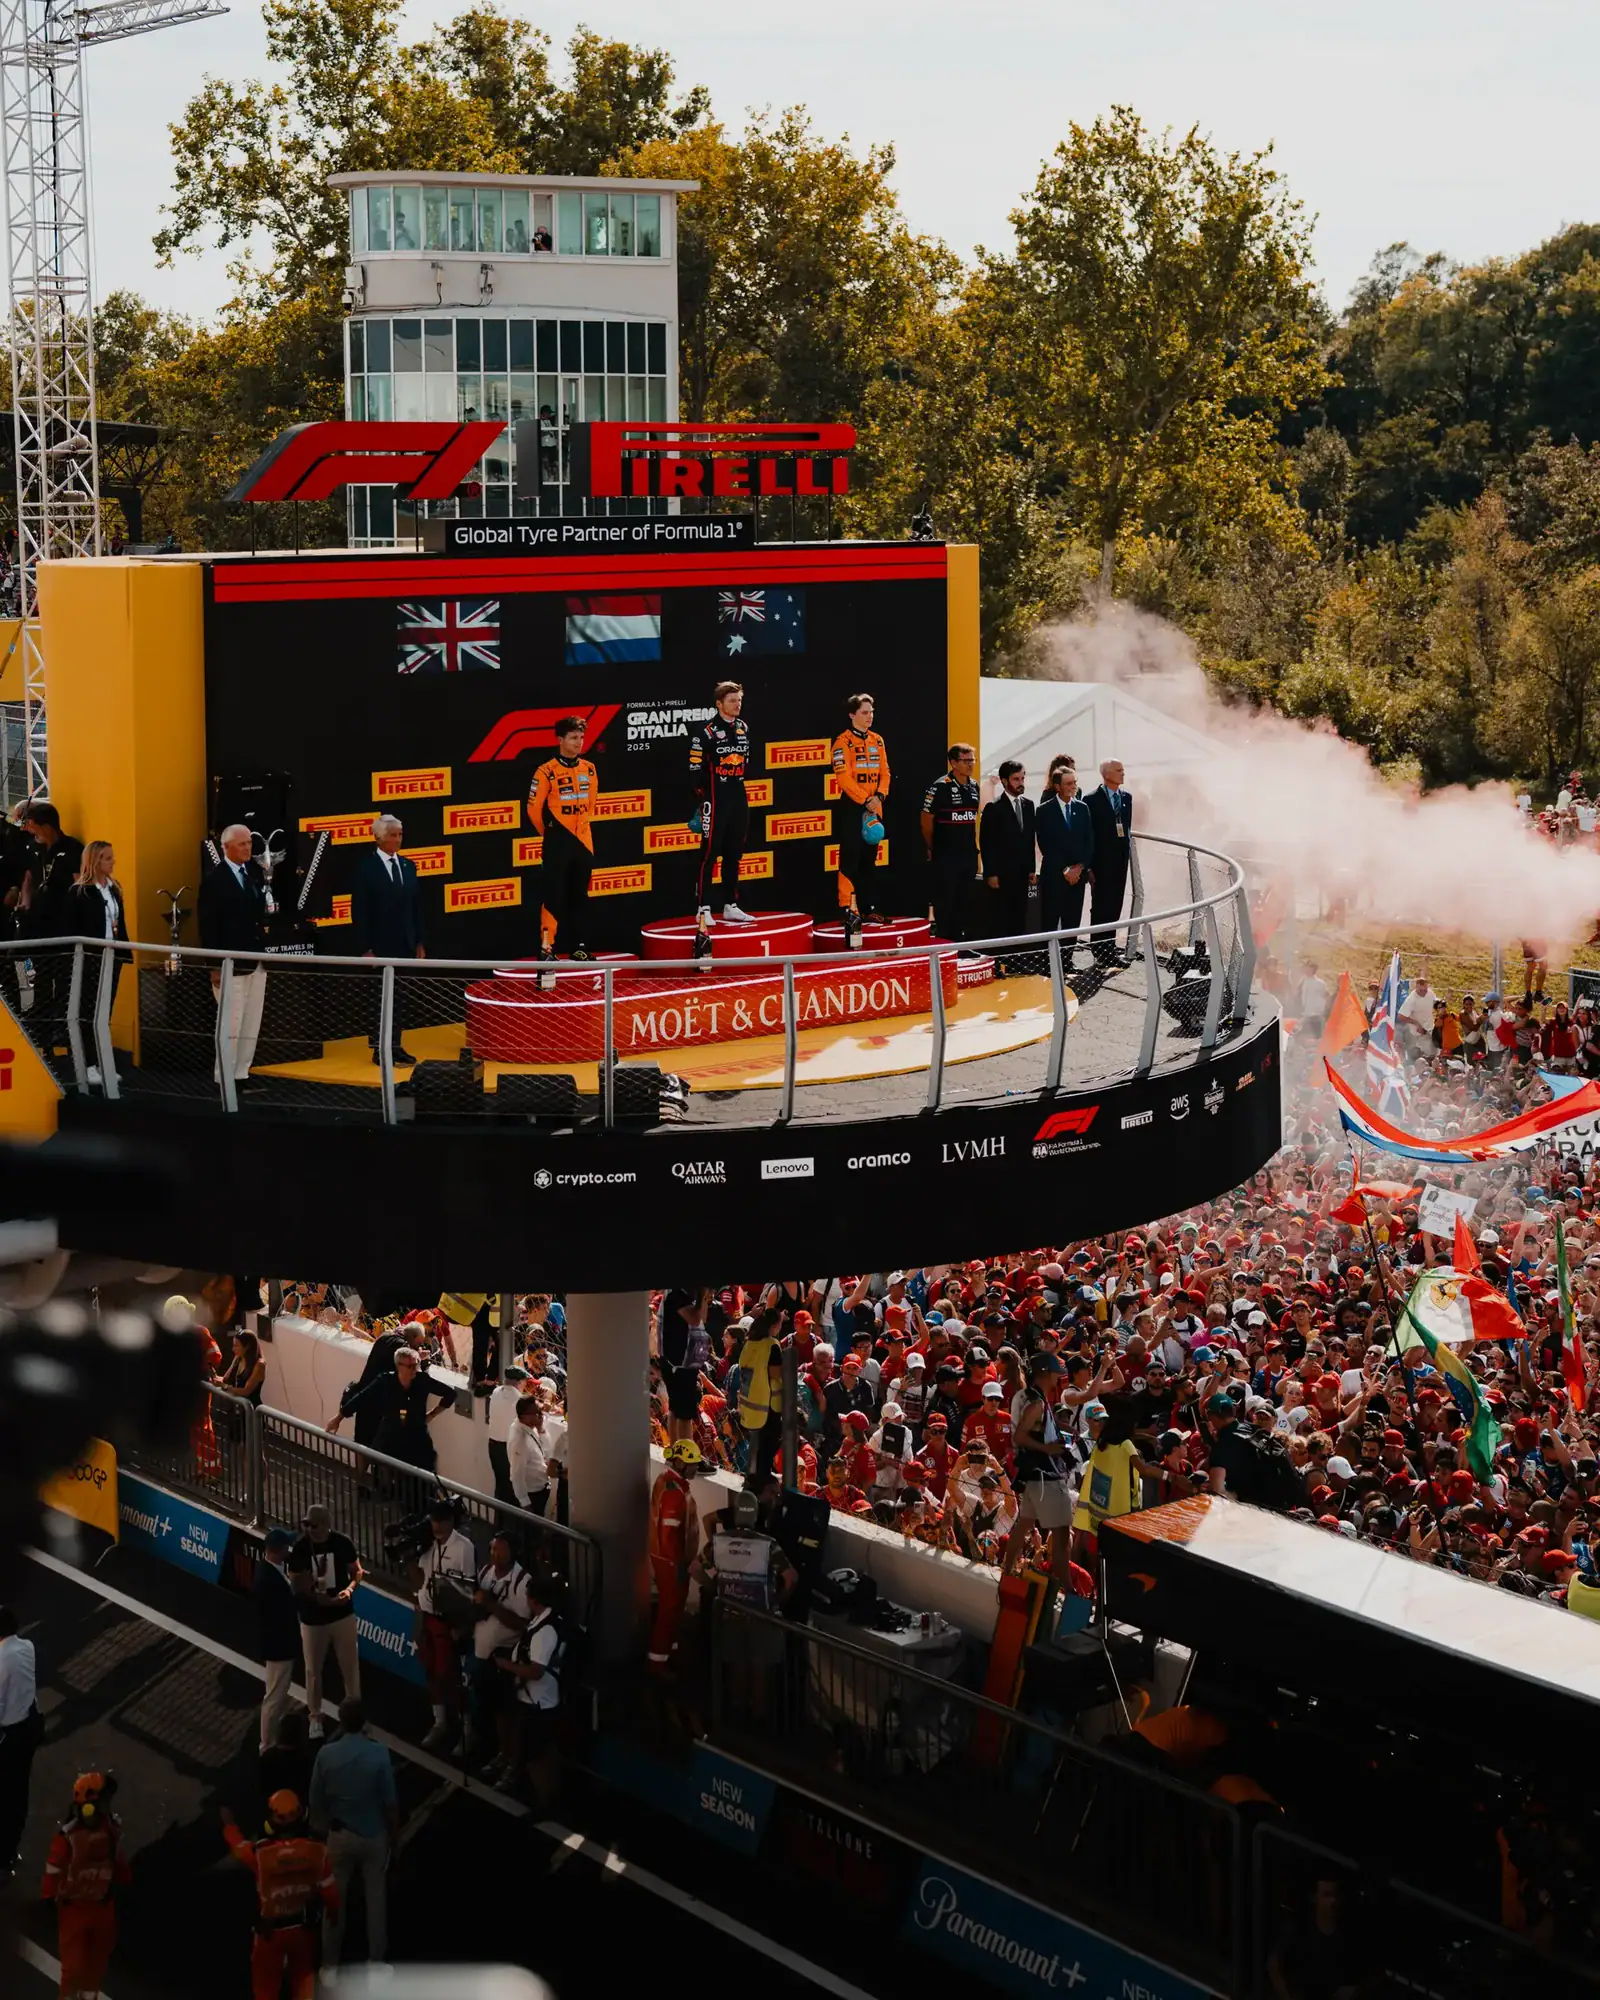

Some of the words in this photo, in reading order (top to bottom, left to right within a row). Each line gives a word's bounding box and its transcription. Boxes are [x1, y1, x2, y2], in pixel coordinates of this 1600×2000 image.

[590, 421, 857, 497] PIRELLI
[455, 526, 512, 544] Global
[517, 525, 558, 546] Tyre
[562, 525, 628, 542] Partner
[632, 523, 650, 541] of
[654, 523, 724, 541] Formula
[627, 710, 671, 725] GRAN
[672, 707, 718, 722] PREM
[627, 723, 689, 740] D'ITALIA
[627, 743, 650, 751] 2025
[771, 744, 826, 764] PIRELLI
[378, 772, 445, 795] PIRELLI
[450, 806, 514, 829] PIRELLI
[771, 815, 826, 836] PIRELLI
[650, 827, 702, 848] PIRELL
[451, 883, 515, 907] PIRELLI
[280, 943, 305, 951] TRAVELS
[760, 940, 771, 957] 1
[896, 935, 904, 947] 3
[592, 975, 602, 990] 2
[629, 997, 726, 1046] MOËT
[732, 998, 753, 1031] &
[1170, 1094, 1189, 1111] aws
[1121, 1110, 1153, 1130] PIRELLI
[941, 1136, 1007, 1163] LVMH
[671, 1160, 726, 1178] QATAR
[766, 1162, 810, 1174] Lenovo
[847, 1152, 911, 1169] aramco
[556, 1172, 637, 1186] crypto.com
[684, 1174, 727, 1185] AIRWAYS
[188, 1523, 210, 1545] NEW
[180, 1536, 218, 1566] SEASON
[712, 1776, 744, 1803] NEW
[700, 1793, 756, 1833] SEASON
[913, 1876, 1088, 1988] Paramount+
